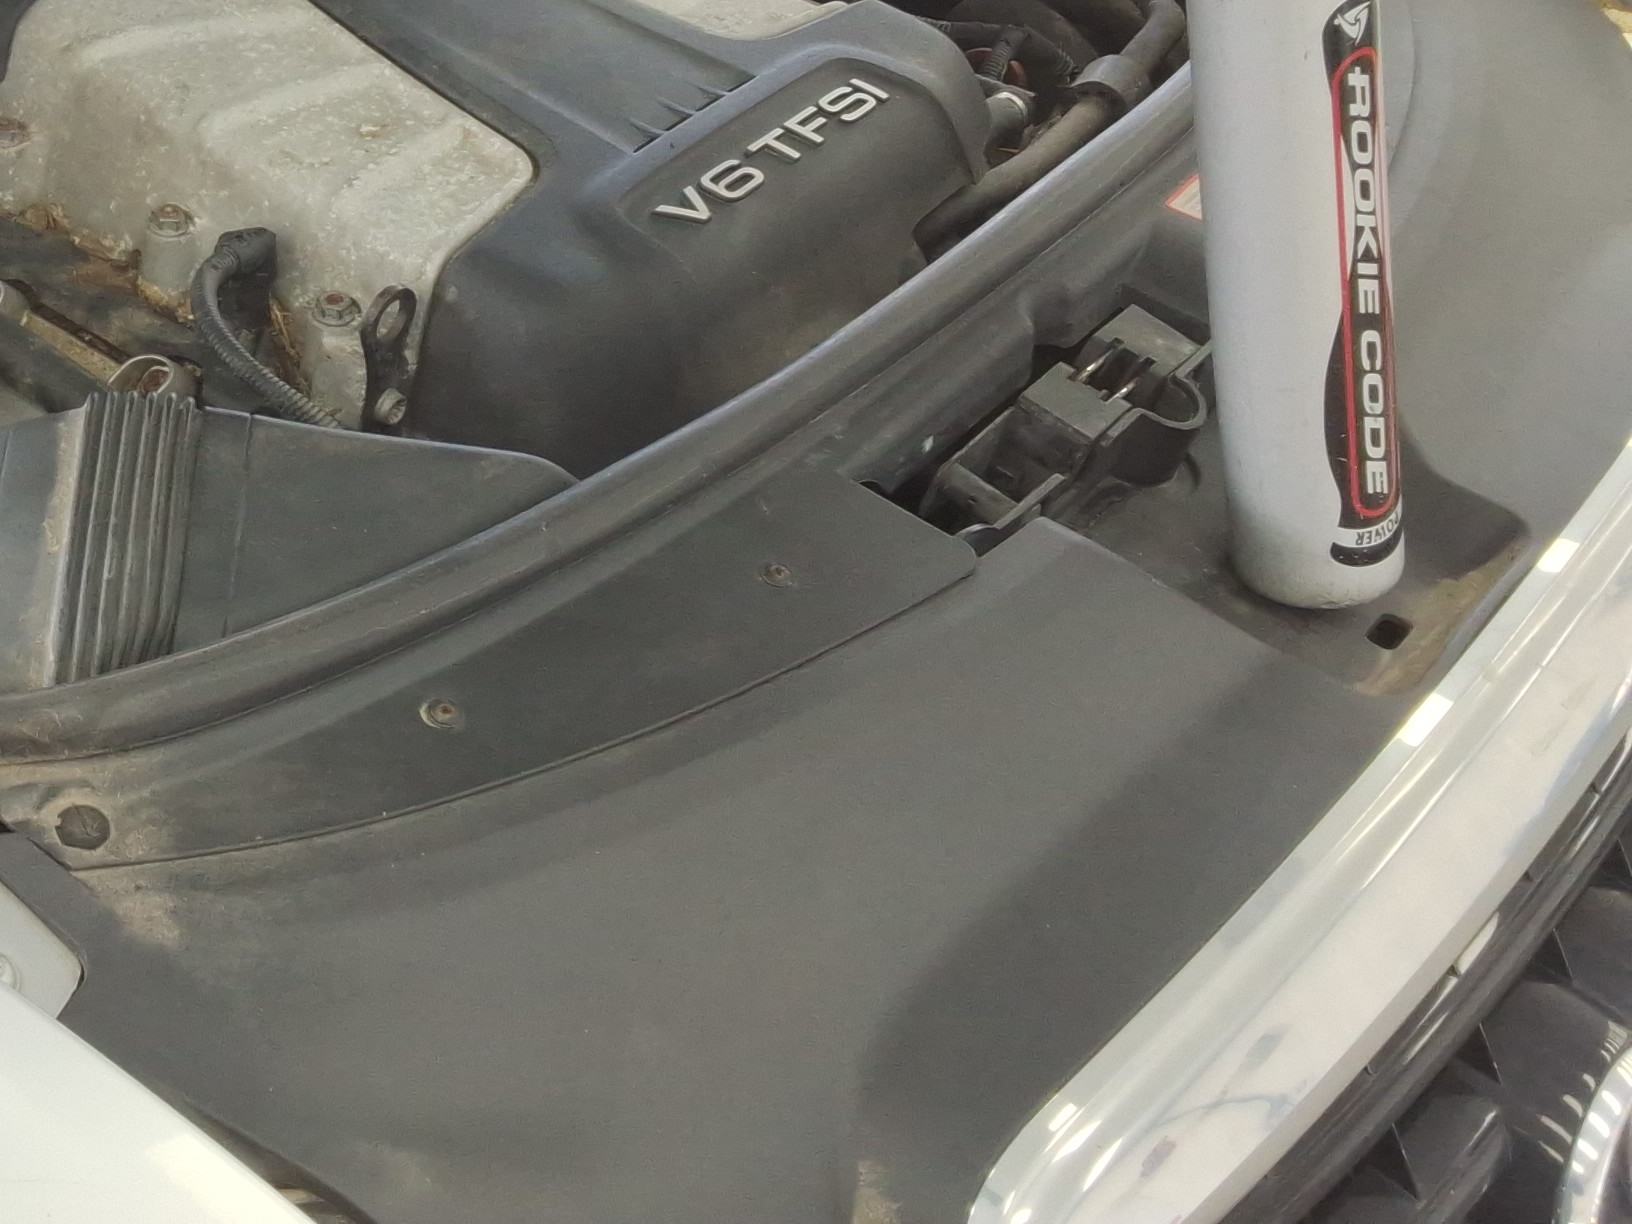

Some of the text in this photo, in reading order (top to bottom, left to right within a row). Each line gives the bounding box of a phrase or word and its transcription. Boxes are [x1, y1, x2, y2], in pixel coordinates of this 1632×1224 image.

[653, 78, 890, 223] V6 TFSI
[1348, 67, 1389, 494] ROOKIE CODE
[1355, 511, 1399, 546] POWER
